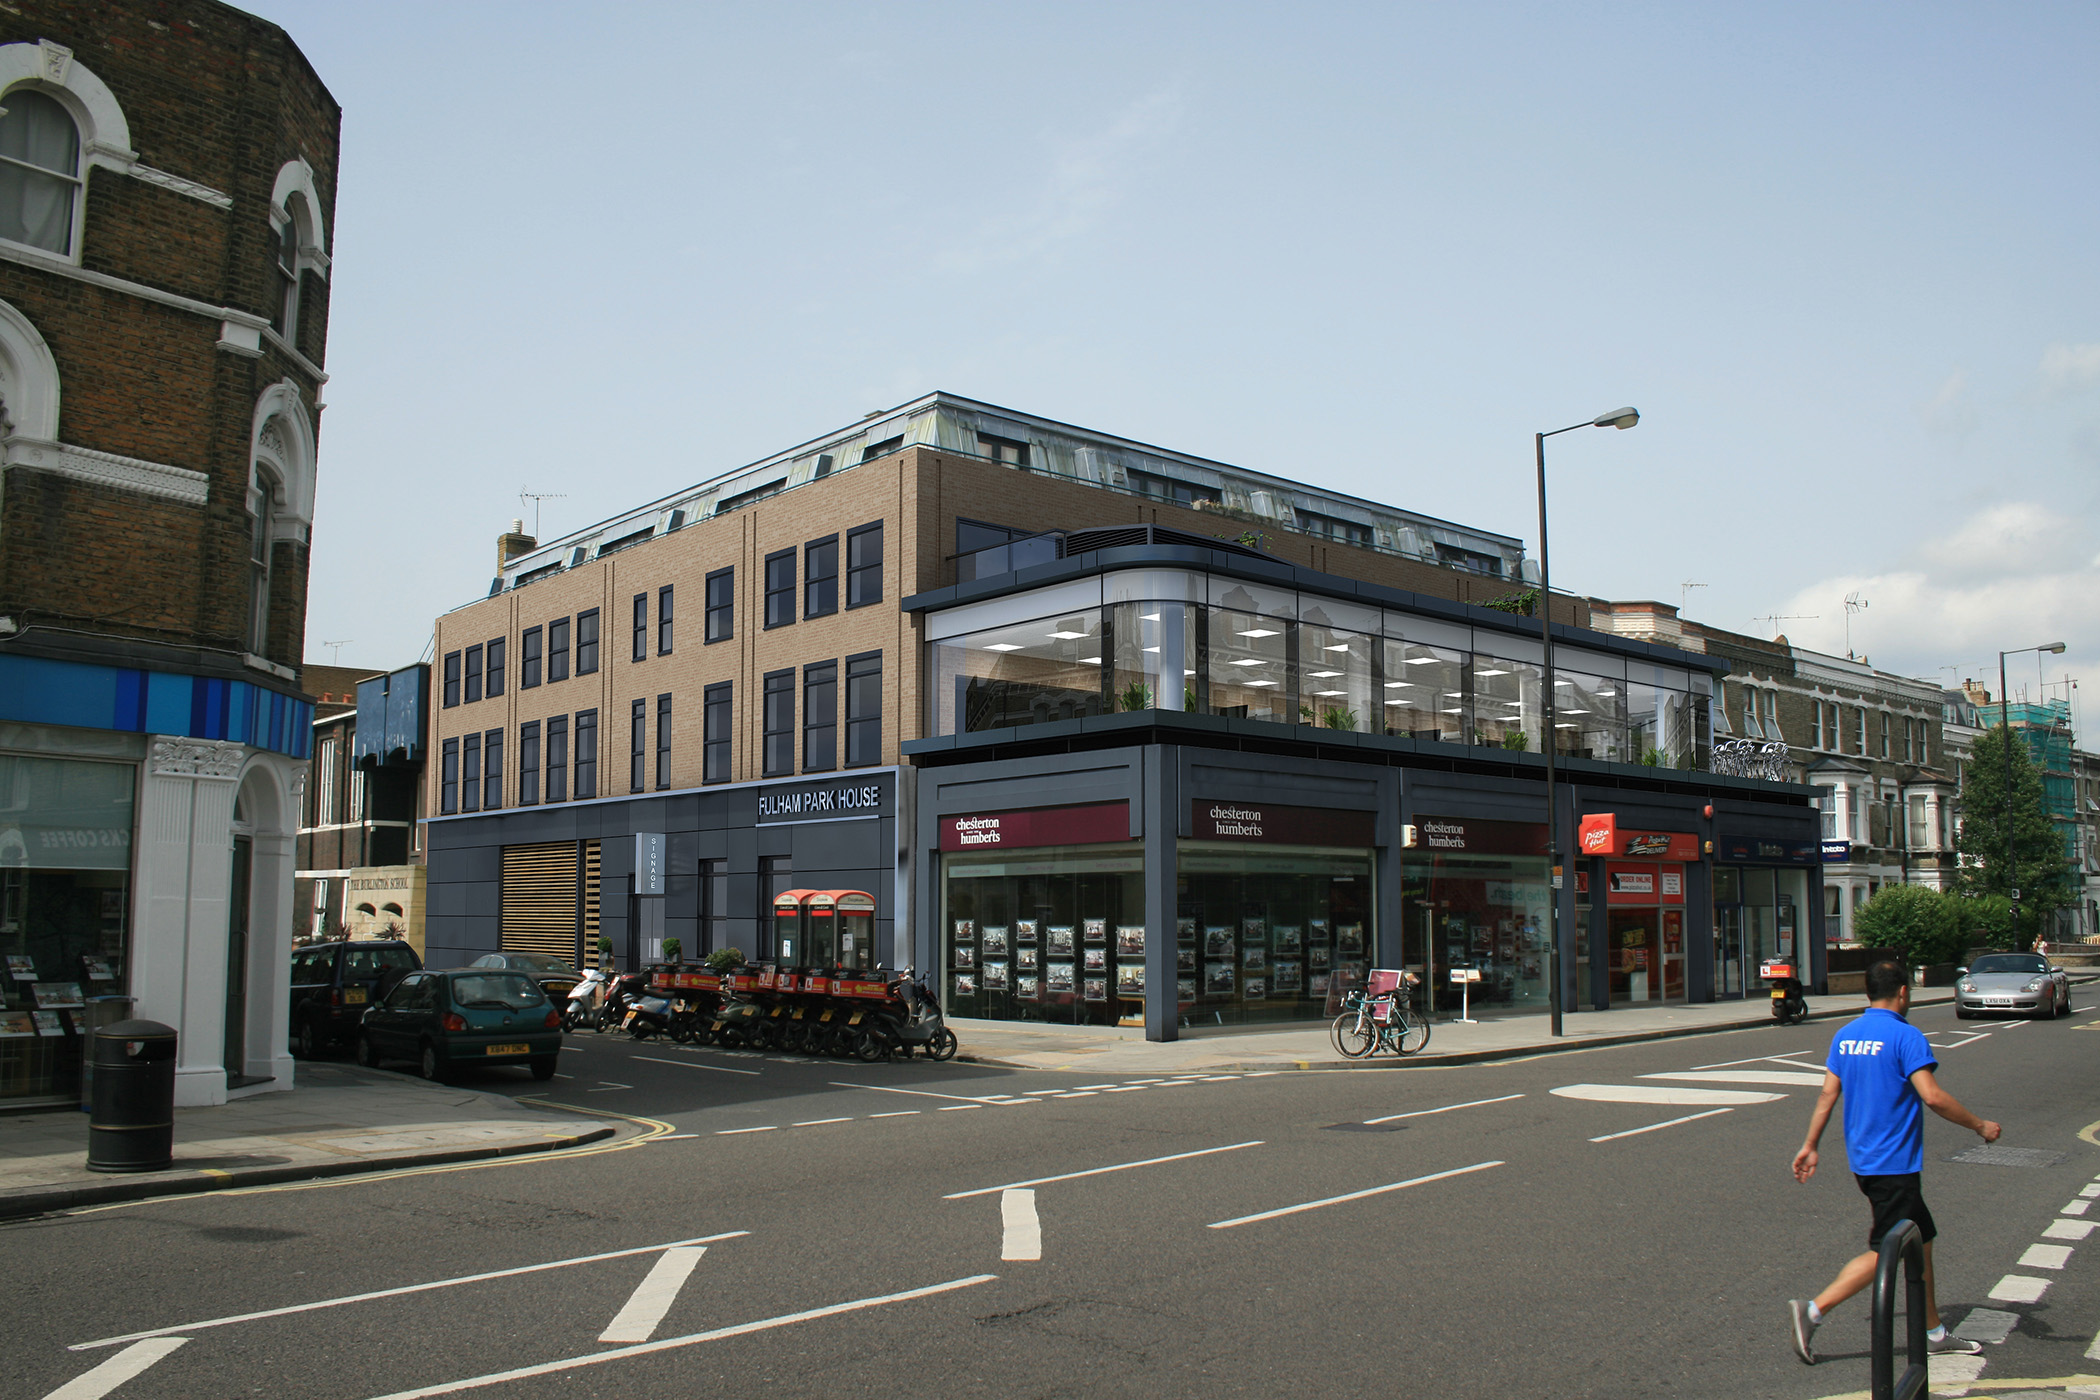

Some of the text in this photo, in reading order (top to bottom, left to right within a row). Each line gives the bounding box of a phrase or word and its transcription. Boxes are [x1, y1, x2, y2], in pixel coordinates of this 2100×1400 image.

[759, 786, 879, 815] FULHAM PARK HOUSE
[1210, 805, 1262, 821] chesterton
[955, 816, 1000, 831] chesterton
[1216, 821, 1263, 837] humberts
[1423, 820, 1464, 835] chesterton
[960, 830, 1001, 845] humberts
[1428, 835, 1465, 848] humberts
[1589, 836, 1607, 848] Hut
[1636, 876, 1652, 884] ONLINE
[1838, 1040, 1885, 1056] STAFF
